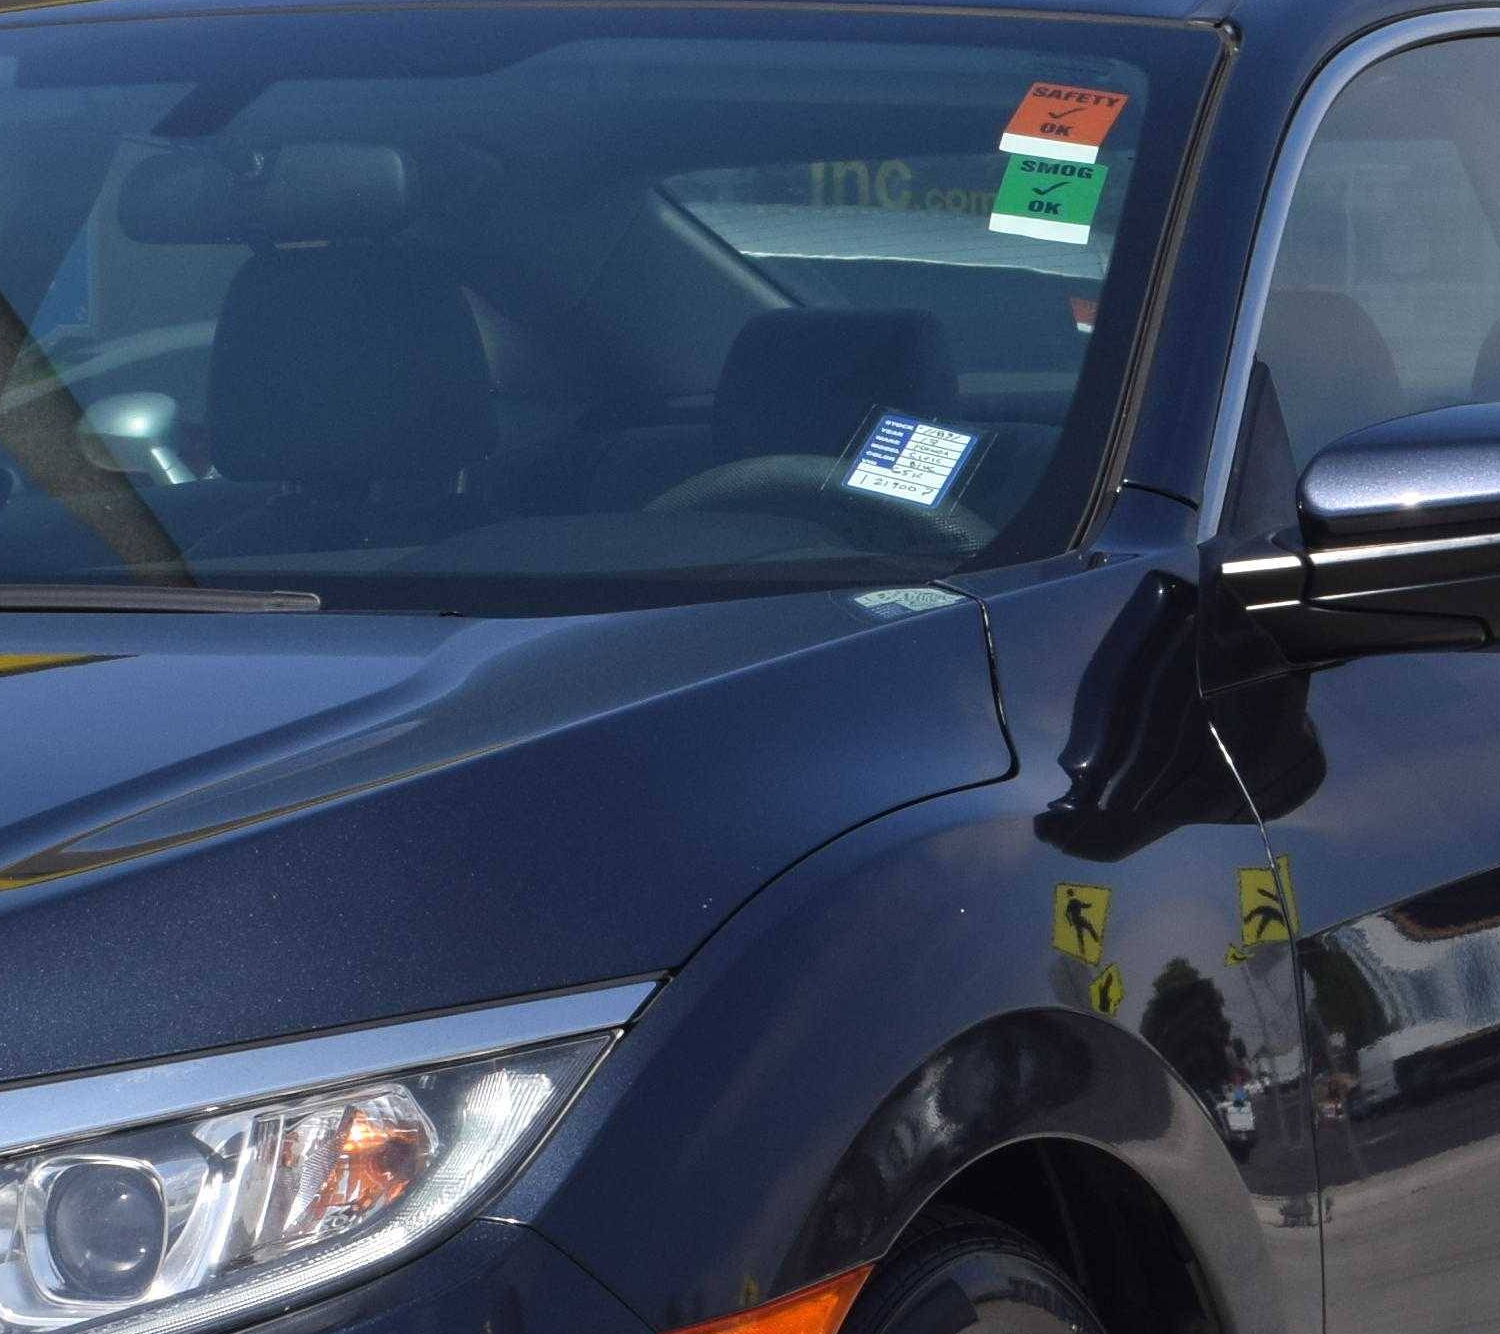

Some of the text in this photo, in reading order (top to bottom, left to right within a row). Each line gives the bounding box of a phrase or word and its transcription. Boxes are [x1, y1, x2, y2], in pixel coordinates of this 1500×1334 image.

[1032, 86, 1120, 107] SAFETY
[1040, 122, 1072, 136] OK
[1020, 160, 1095, 180] SMOG
[1028, 200, 1062, 215] OK
